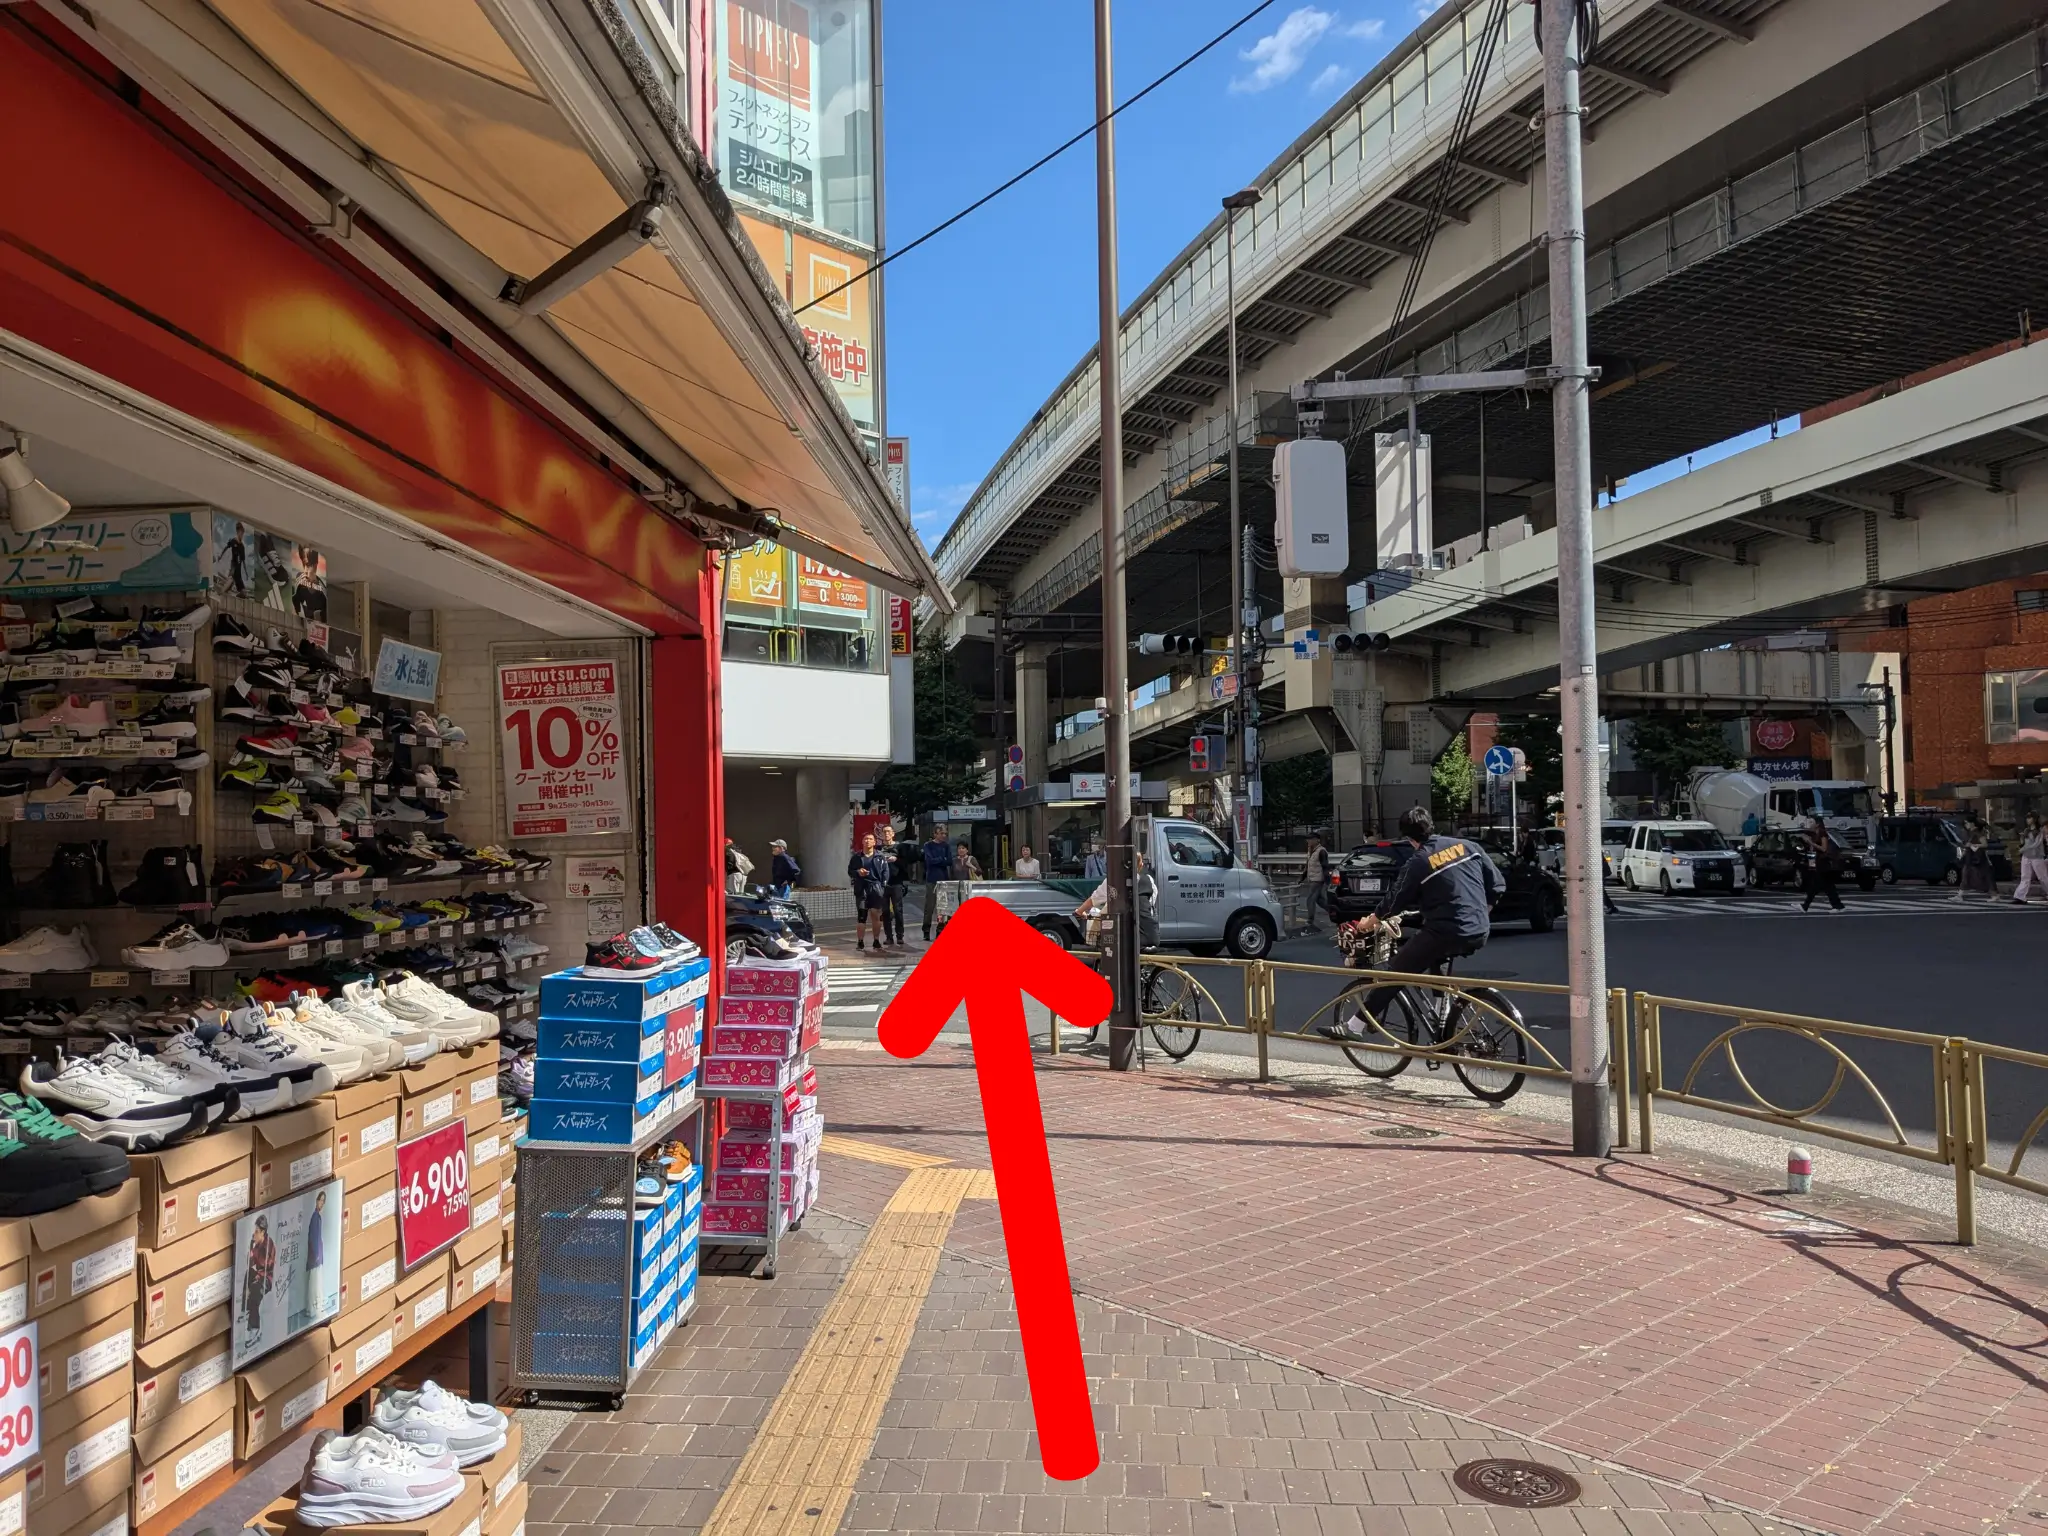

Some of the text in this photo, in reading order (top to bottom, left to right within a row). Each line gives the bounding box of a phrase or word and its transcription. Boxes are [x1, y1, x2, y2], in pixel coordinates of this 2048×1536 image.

[738, 6, 800, 71] TIPNESS
[728, 89, 811, 132] フィットネスクラブ
[728, 109, 812, 161] ティップネス
[738, 149, 804, 185] ジムエリア
[736, 168, 808, 208] 24時間営業
[4, 553, 103, 585] スニーカー
[394, 653, 434, 687] 水に強い
[531, 666, 611, 683] kutsu.com
[510, 681, 606, 698] アプリ会員様限定
[586, 751, 620, 766] OFF
[1752, 760, 1810, 772] 処方せん受付
[514, 767, 617, 786] クーポンセール
[538, 783, 595, 800] 開催中!!
[1428, 843, 1465, 869] NAVY
[1180, 891, 1205, 899] 株式会社
[564, 992, 619, 1010] スパットシューズ
[250, 1008, 265, 1020] FILA
[560, 1033, 617, 1049] スパットシューズ
[668, 1022, 696, 1056] 3,900
[170, 1061, 191, 1072] FILA
[68, 1086, 93, 1095] FILA
[557, 1074, 613, 1090] スパットシューズ
[552, 1113, 610, 1131] スパットシューズ
[446, 1188, 468, 1216] 7,590
[162, 1226, 177, 1240] FILA
[150, 1320, 164, 1334] FILA
[140, 1408, 156, 1424] FILA
[403, 1428, 428, 1439] FILA
[359, 1478, 387, 1489] FILA
[141, 1500, 157, 1518] FILA
